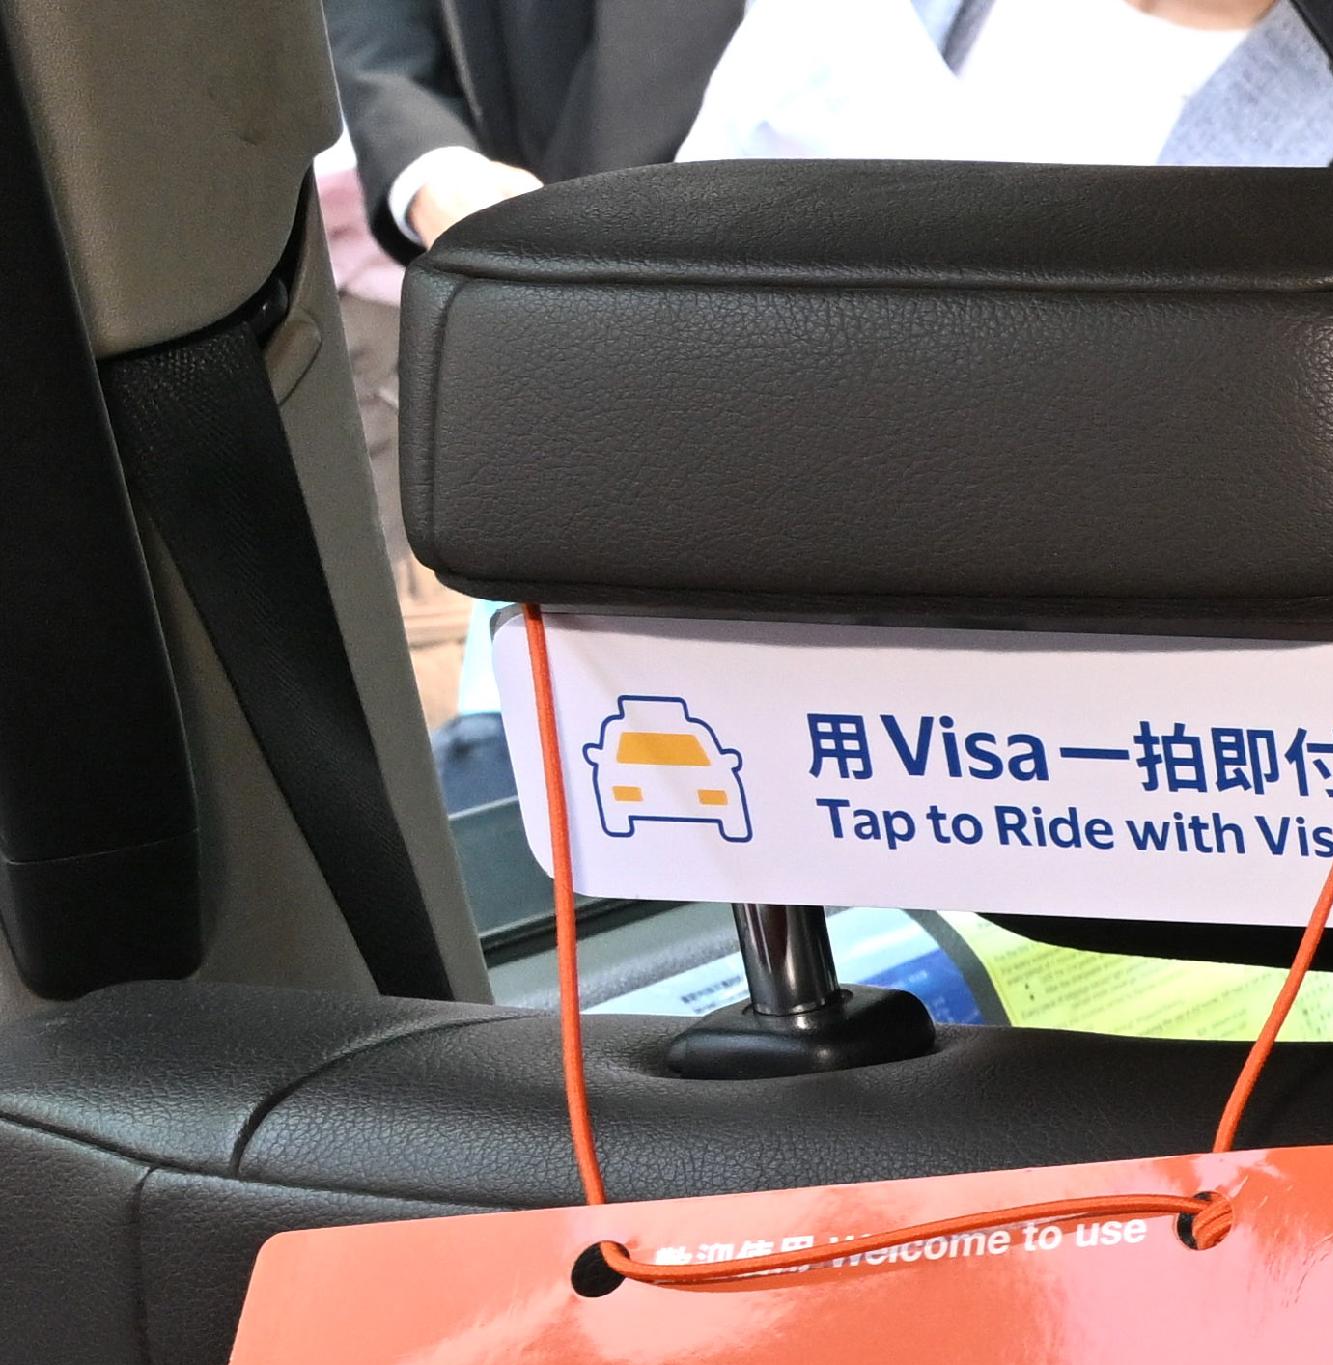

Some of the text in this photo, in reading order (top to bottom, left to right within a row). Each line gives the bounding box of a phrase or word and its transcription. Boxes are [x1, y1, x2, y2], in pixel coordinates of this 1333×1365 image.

[815, 798, 915, 849] Tap
[932, 804, 984, 844] to
[996, 805, 1114, 848] Ride
[1125, 810, 1246, 854] with
[1024, 1216, 1061, 1251] to
[1075, 1219, 1147, 1249] use
